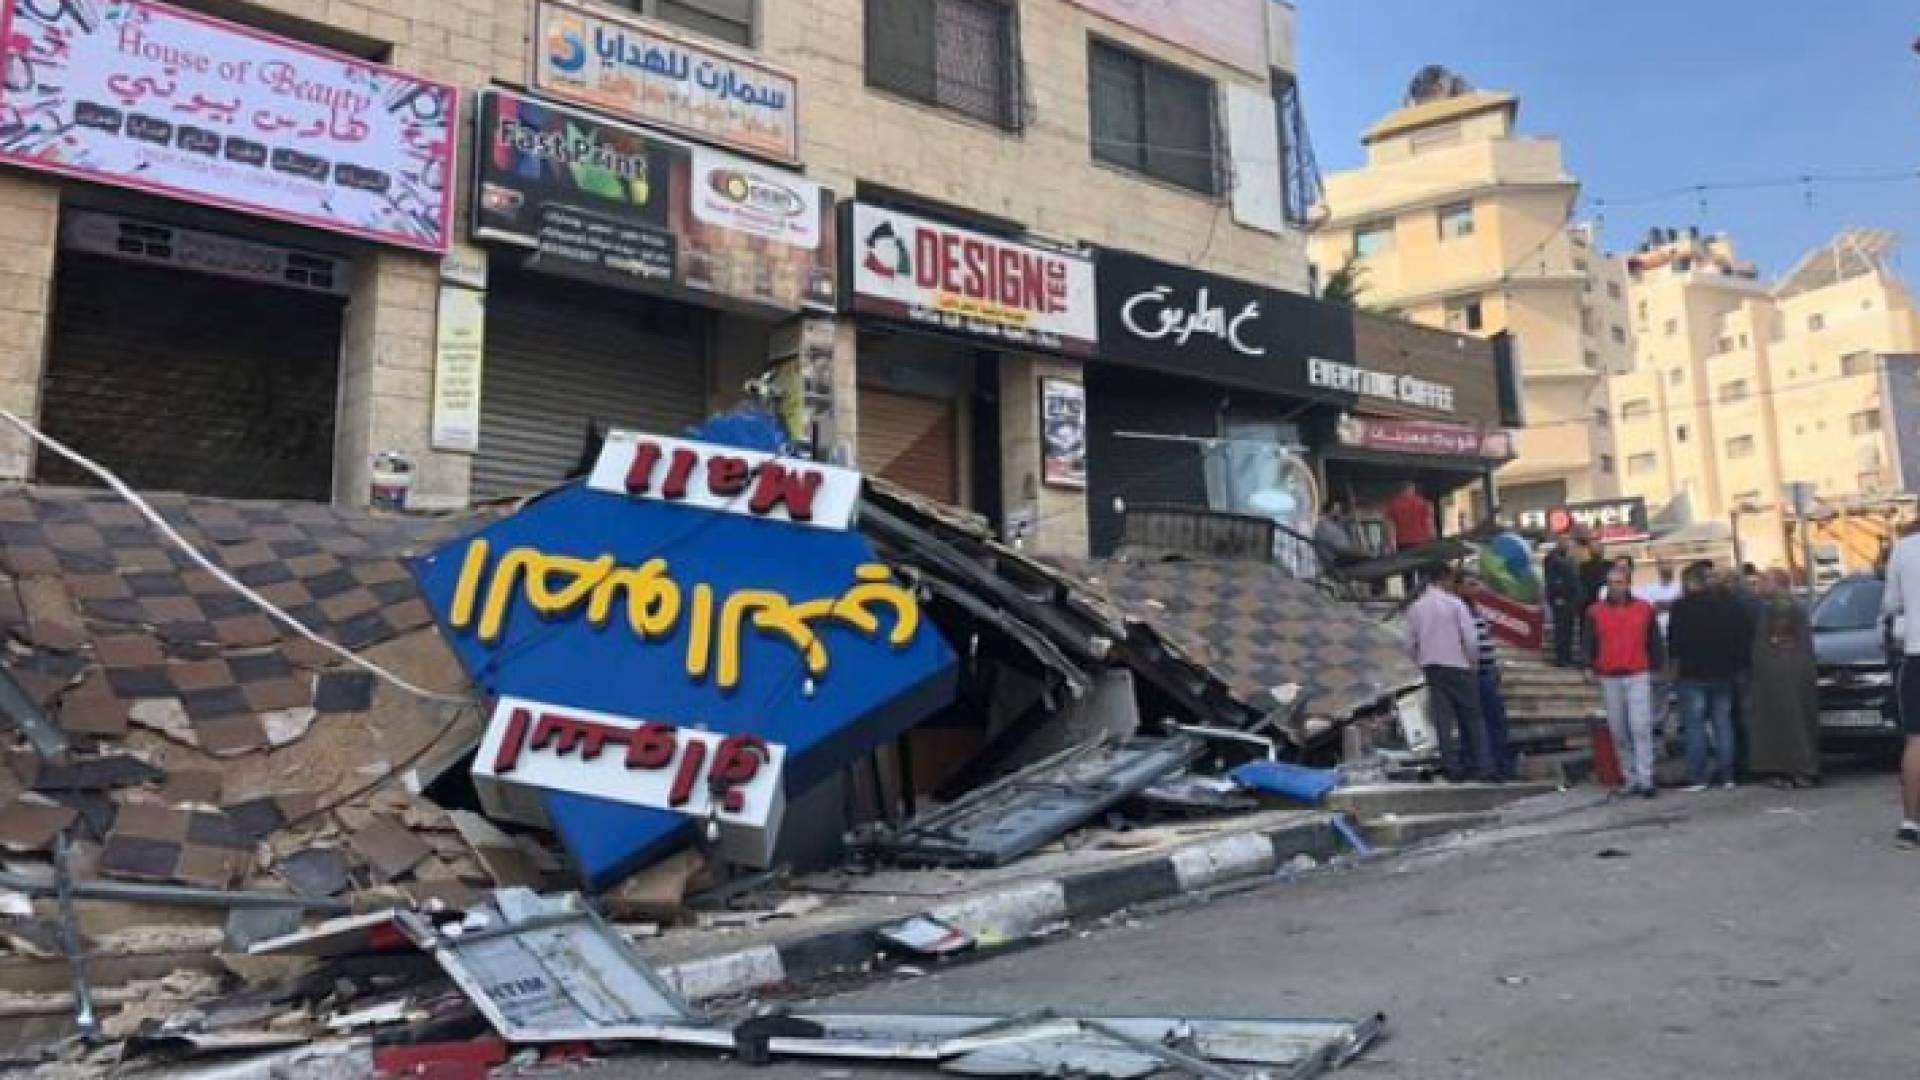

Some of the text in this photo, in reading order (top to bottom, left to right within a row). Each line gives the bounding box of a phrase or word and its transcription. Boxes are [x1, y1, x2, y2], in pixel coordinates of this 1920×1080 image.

[118, 24, 371, 114] House of Beauty
[595, 26, 689, 80] للهدايا
[697, 61, 786, 109] سمارت
[498, 117, 646, 178] Fast Print
[914, 228, 1045, 313] DESIGN
[1047, 260, 1068, 313] TEC
[1121, 285, 1226, 346] الطريق
[625, 441, 824, 520] Mall
